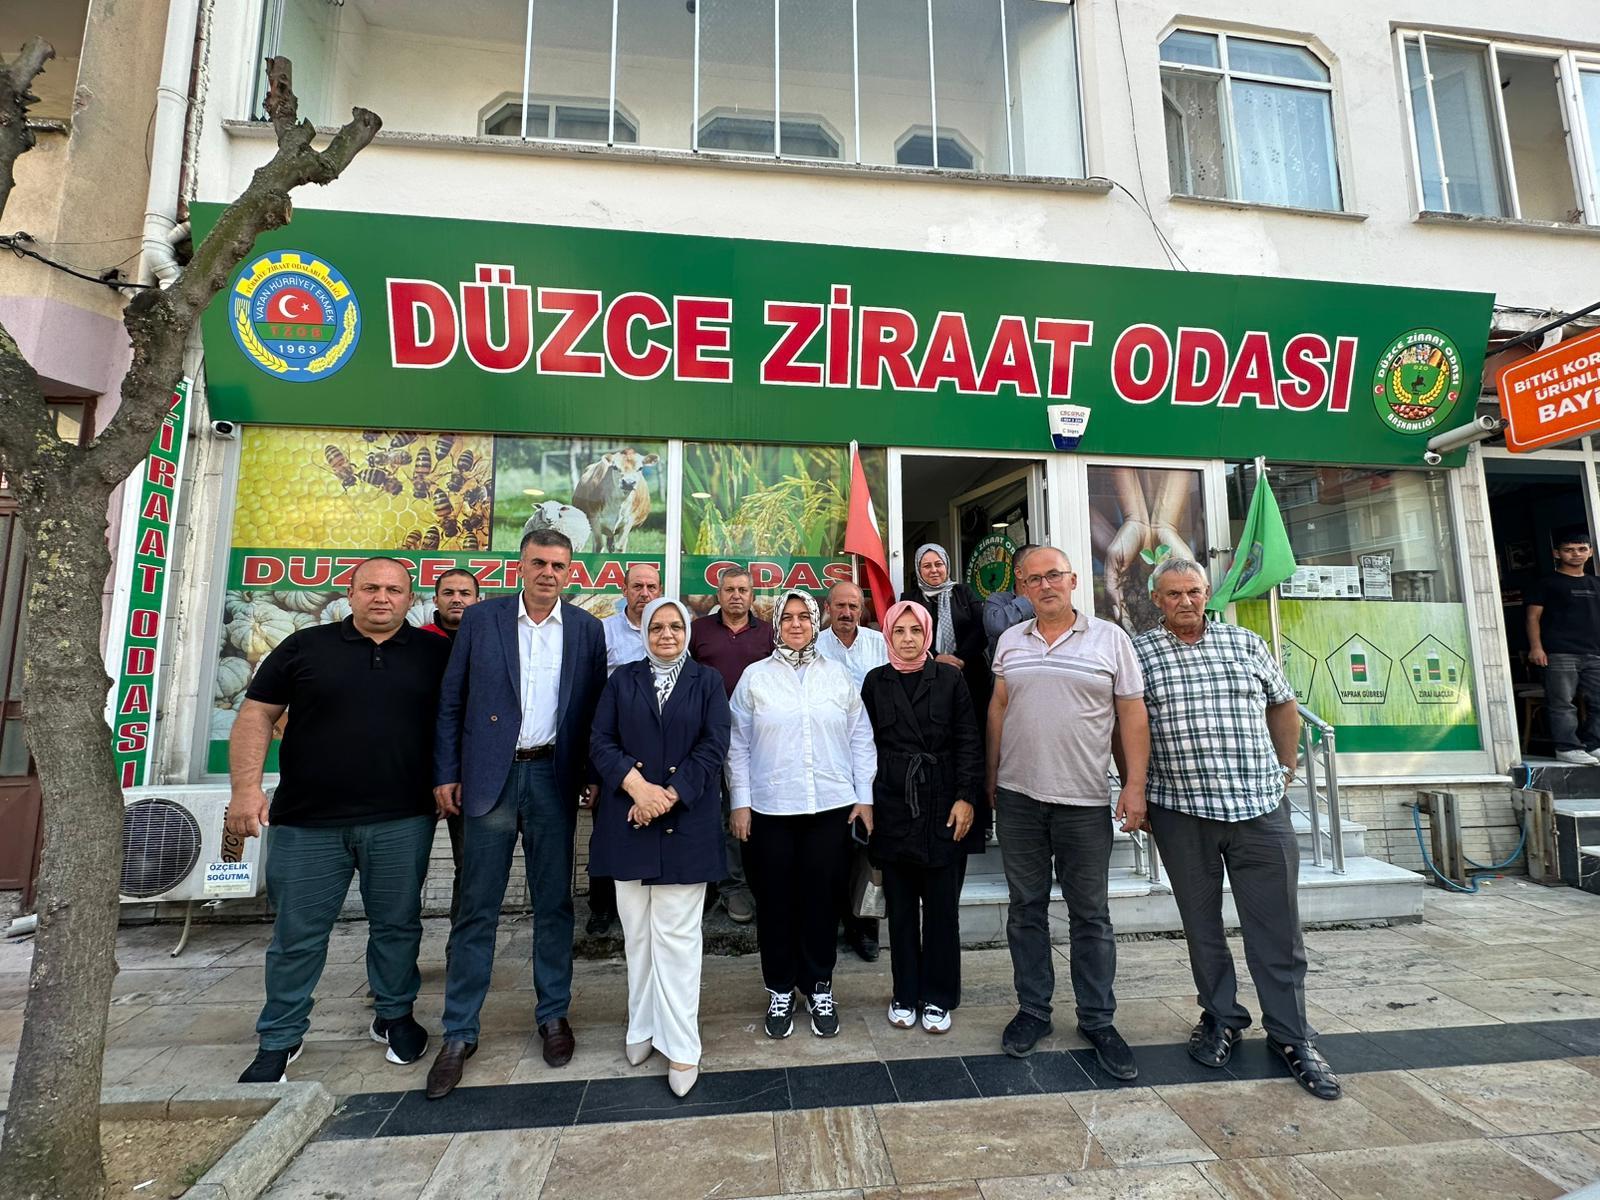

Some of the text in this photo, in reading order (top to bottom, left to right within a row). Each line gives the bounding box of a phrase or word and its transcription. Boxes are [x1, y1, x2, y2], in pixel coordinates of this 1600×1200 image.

[255, 276, 335, 322] VATAN HÜRRİYET EKMEK
[278, 345, 317, 355] 1963
[386, 263, 1359, 413] DÜZCE ZİRAAT ODASI
[1378, 332, 1460, 385] DÜZCE ZİRAAT ODASI
[1513, 351, 1600, 394] BİTKİ KOR
[1387, 413, 1436, 431] BAŞKANLIĞI
[242, 556, 458, 587] DÜZE
[468, 559, 661, 589] ZİAA
[116, 608, 161, 789] ODASI
[1340, 688, 1385, 699] YAPRAK GÜBRESİ
[206, 872, 250, 882] SOĞUTMA
